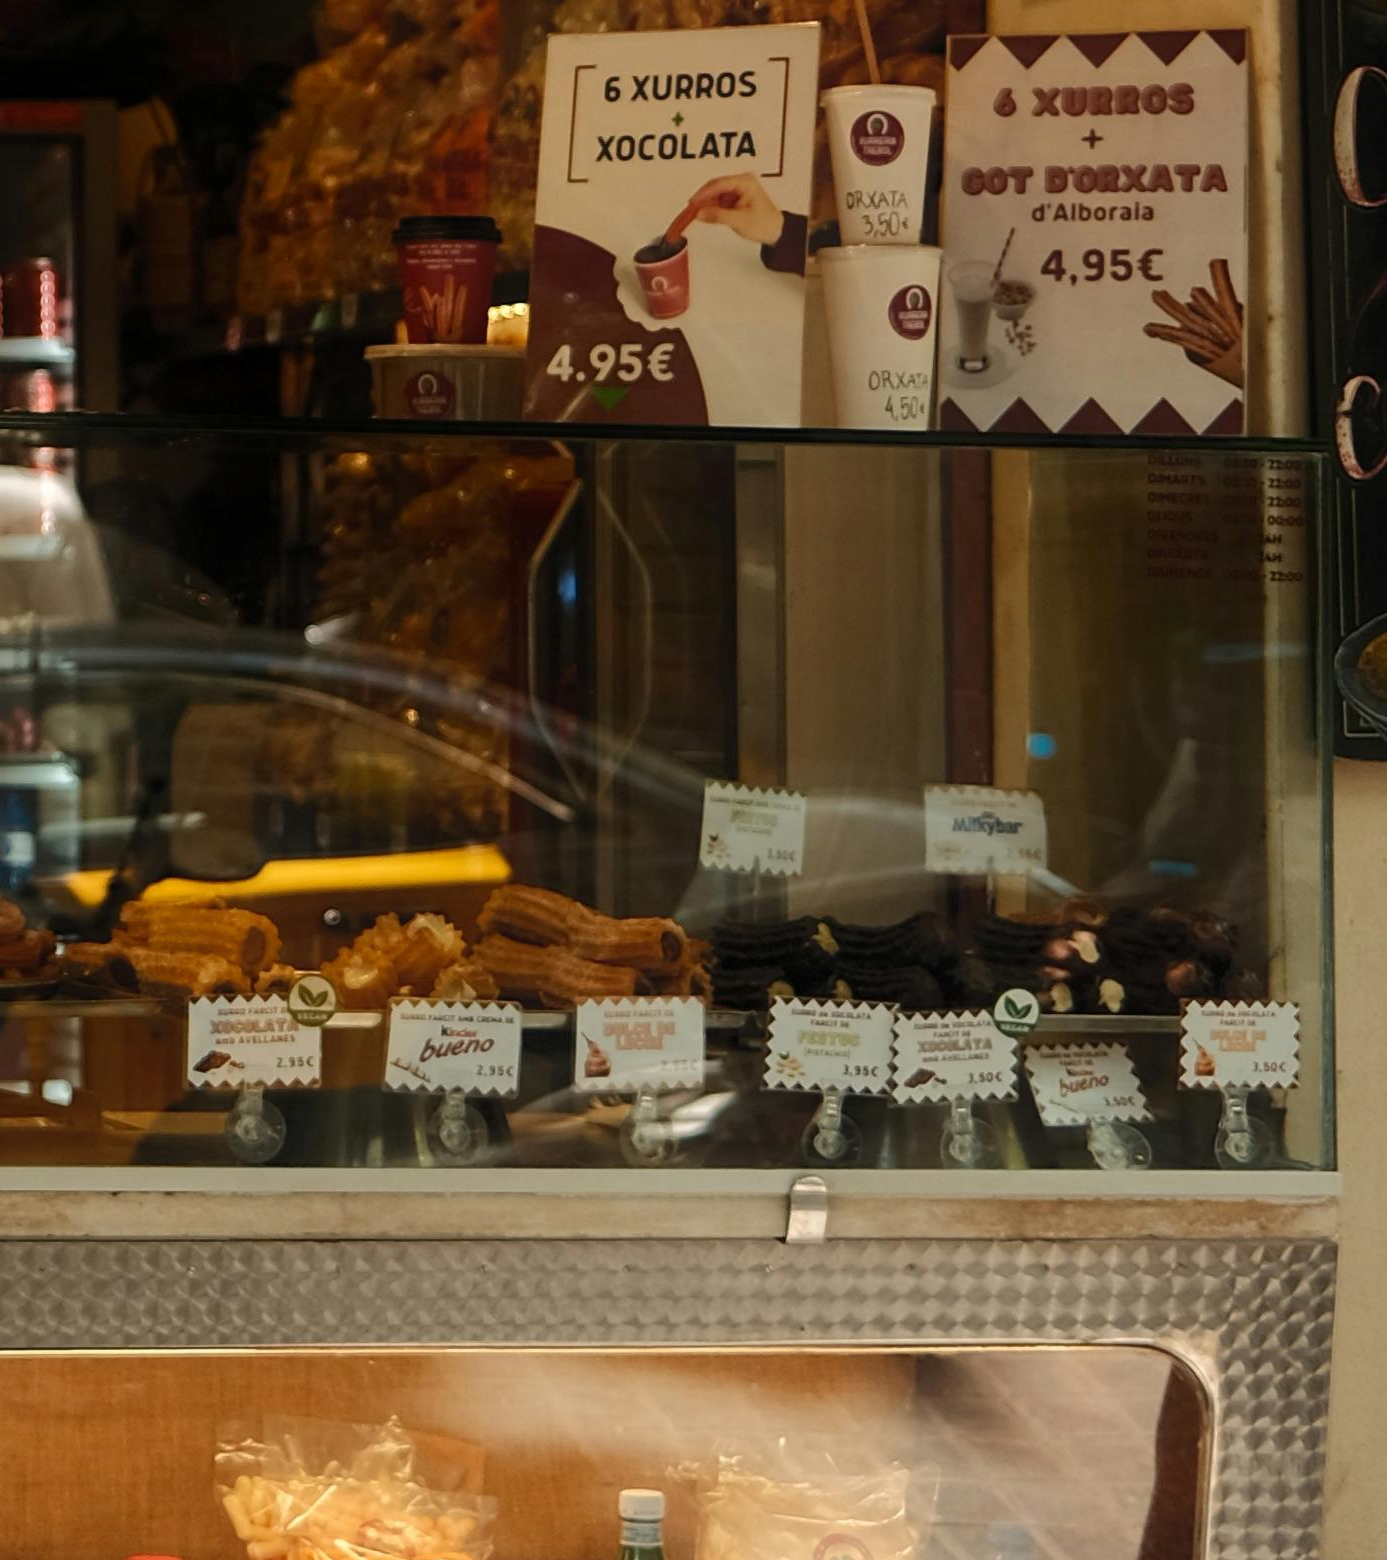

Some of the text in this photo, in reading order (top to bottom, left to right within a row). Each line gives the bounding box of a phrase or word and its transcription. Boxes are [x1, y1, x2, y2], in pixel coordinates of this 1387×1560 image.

[604, 70, 757, 102] 6 XURROS
[993, 82, 1195, 117] 6 XURROS
[595, 130, 757, 163] XOCOLATA
[961, 164, 1228, 196] GOT D'ORXATA
[845, 189, 909, 210] ORXATA
[1040, 247, 1165, 287] 4,95€
[545, 342, 676, 383] 4.95€
[238, 1034, 296, 1045] AVELLANES
[419, 1037, 495, 1063] bueno
